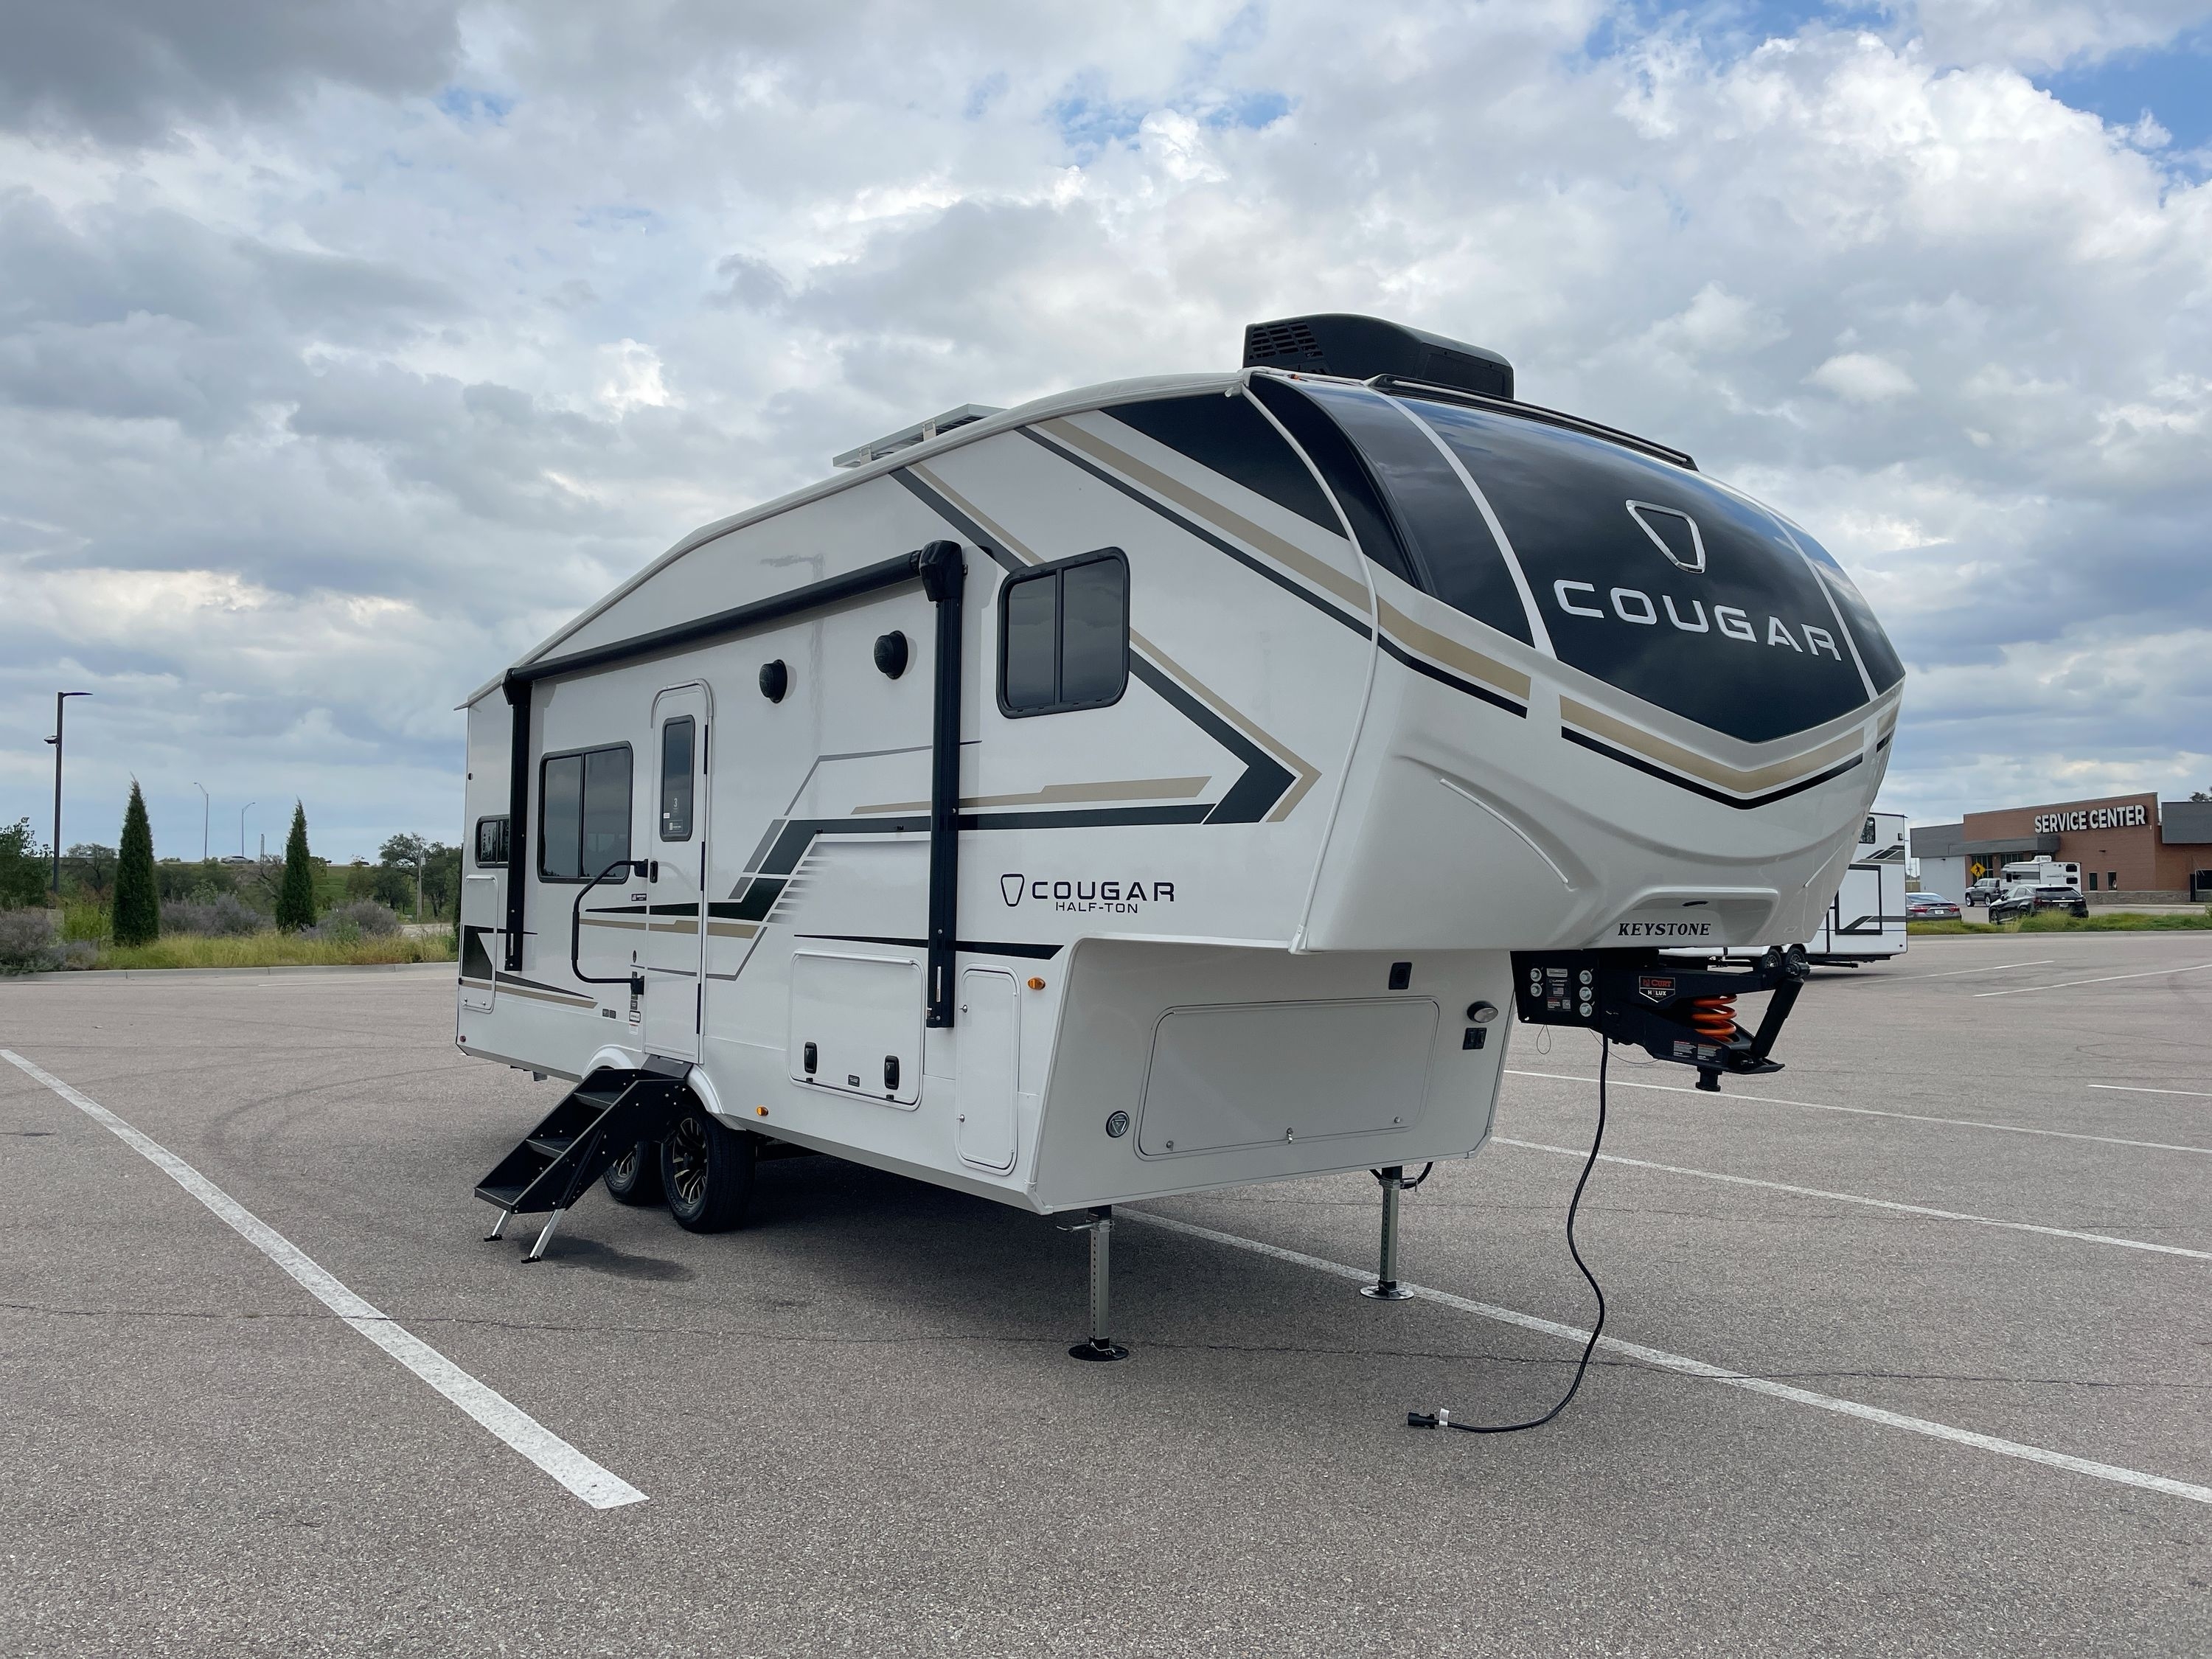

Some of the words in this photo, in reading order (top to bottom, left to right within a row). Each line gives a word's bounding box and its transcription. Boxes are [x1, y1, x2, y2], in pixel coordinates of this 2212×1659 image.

[1553, 579, 1842, 661] COUGAR
[2034, 810, 2087, 834] SERVICE
[2089, 804, 2146, 830] CENTER
[1032, 881, 1175, 902] COUGAR
[1055, 901, 1138, 914] HALF-TON
[1617, 922, 1711, 936] KEYSTONE
